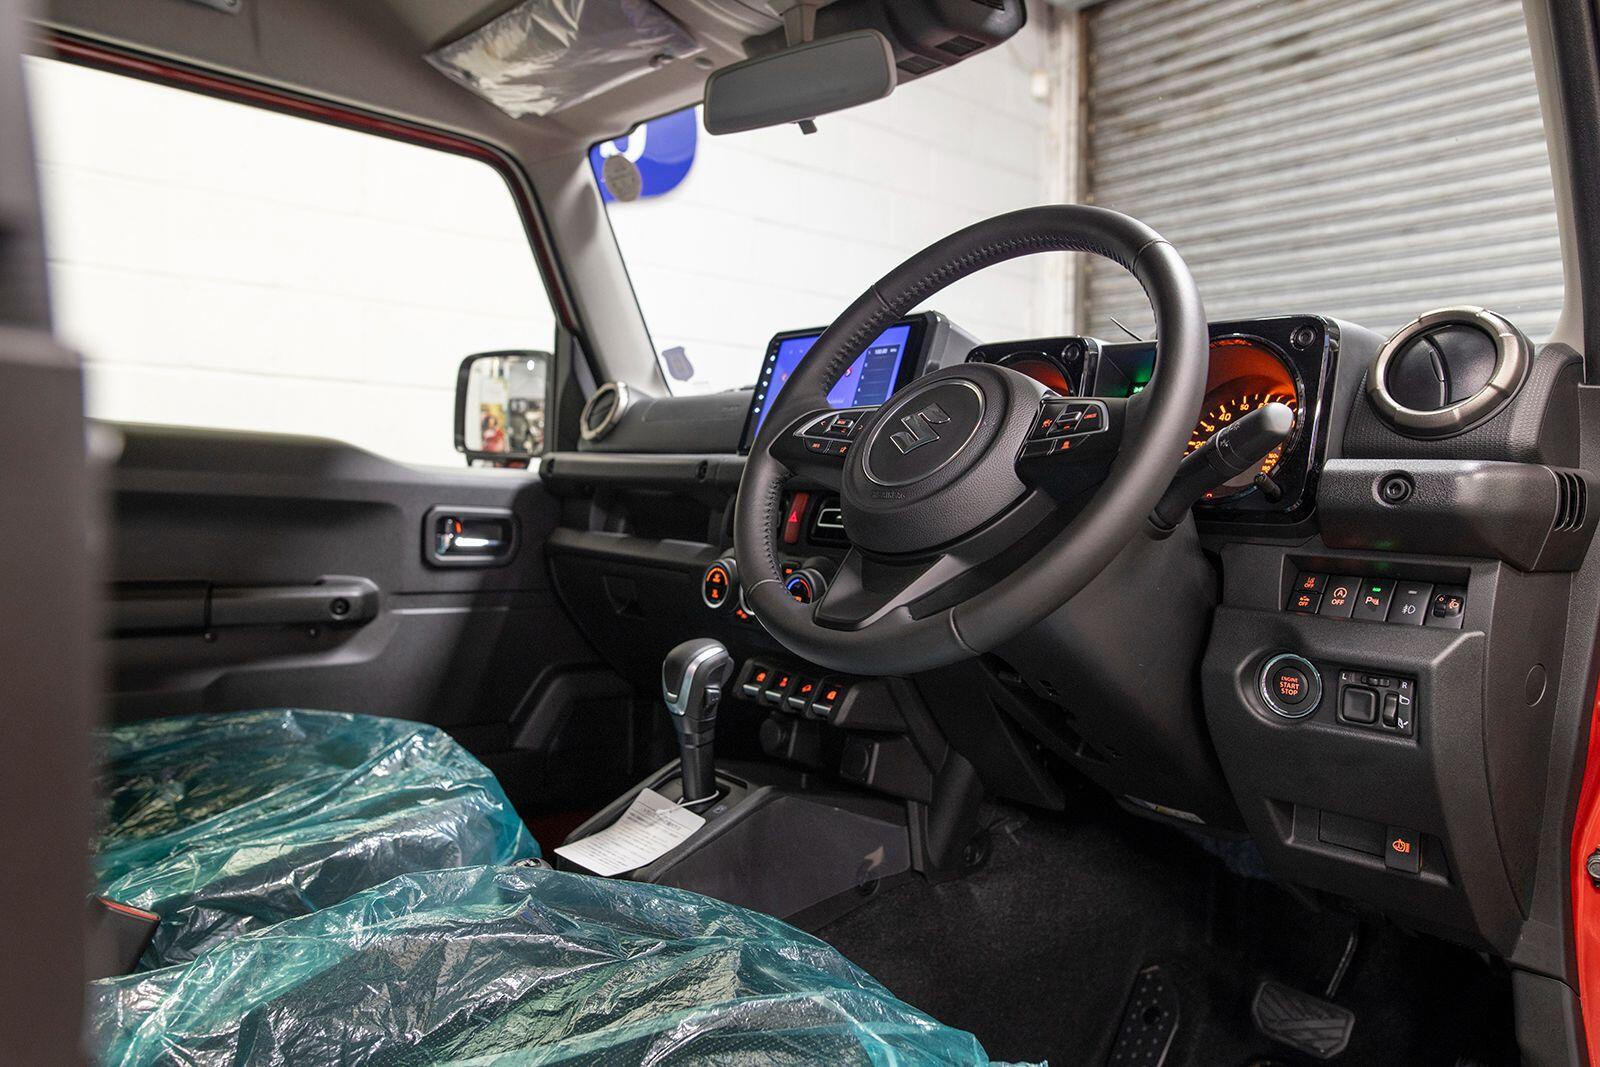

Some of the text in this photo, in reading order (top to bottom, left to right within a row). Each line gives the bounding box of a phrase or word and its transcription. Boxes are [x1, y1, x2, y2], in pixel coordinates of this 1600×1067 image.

[1218, 413, 1232, 422] 40
[1331, 598, 1345, 606] OFF
[1280, 681, 1300, 690] START
[1401, 681, 1408, 689] R
[1281, 688, 1298, 696] STOP
